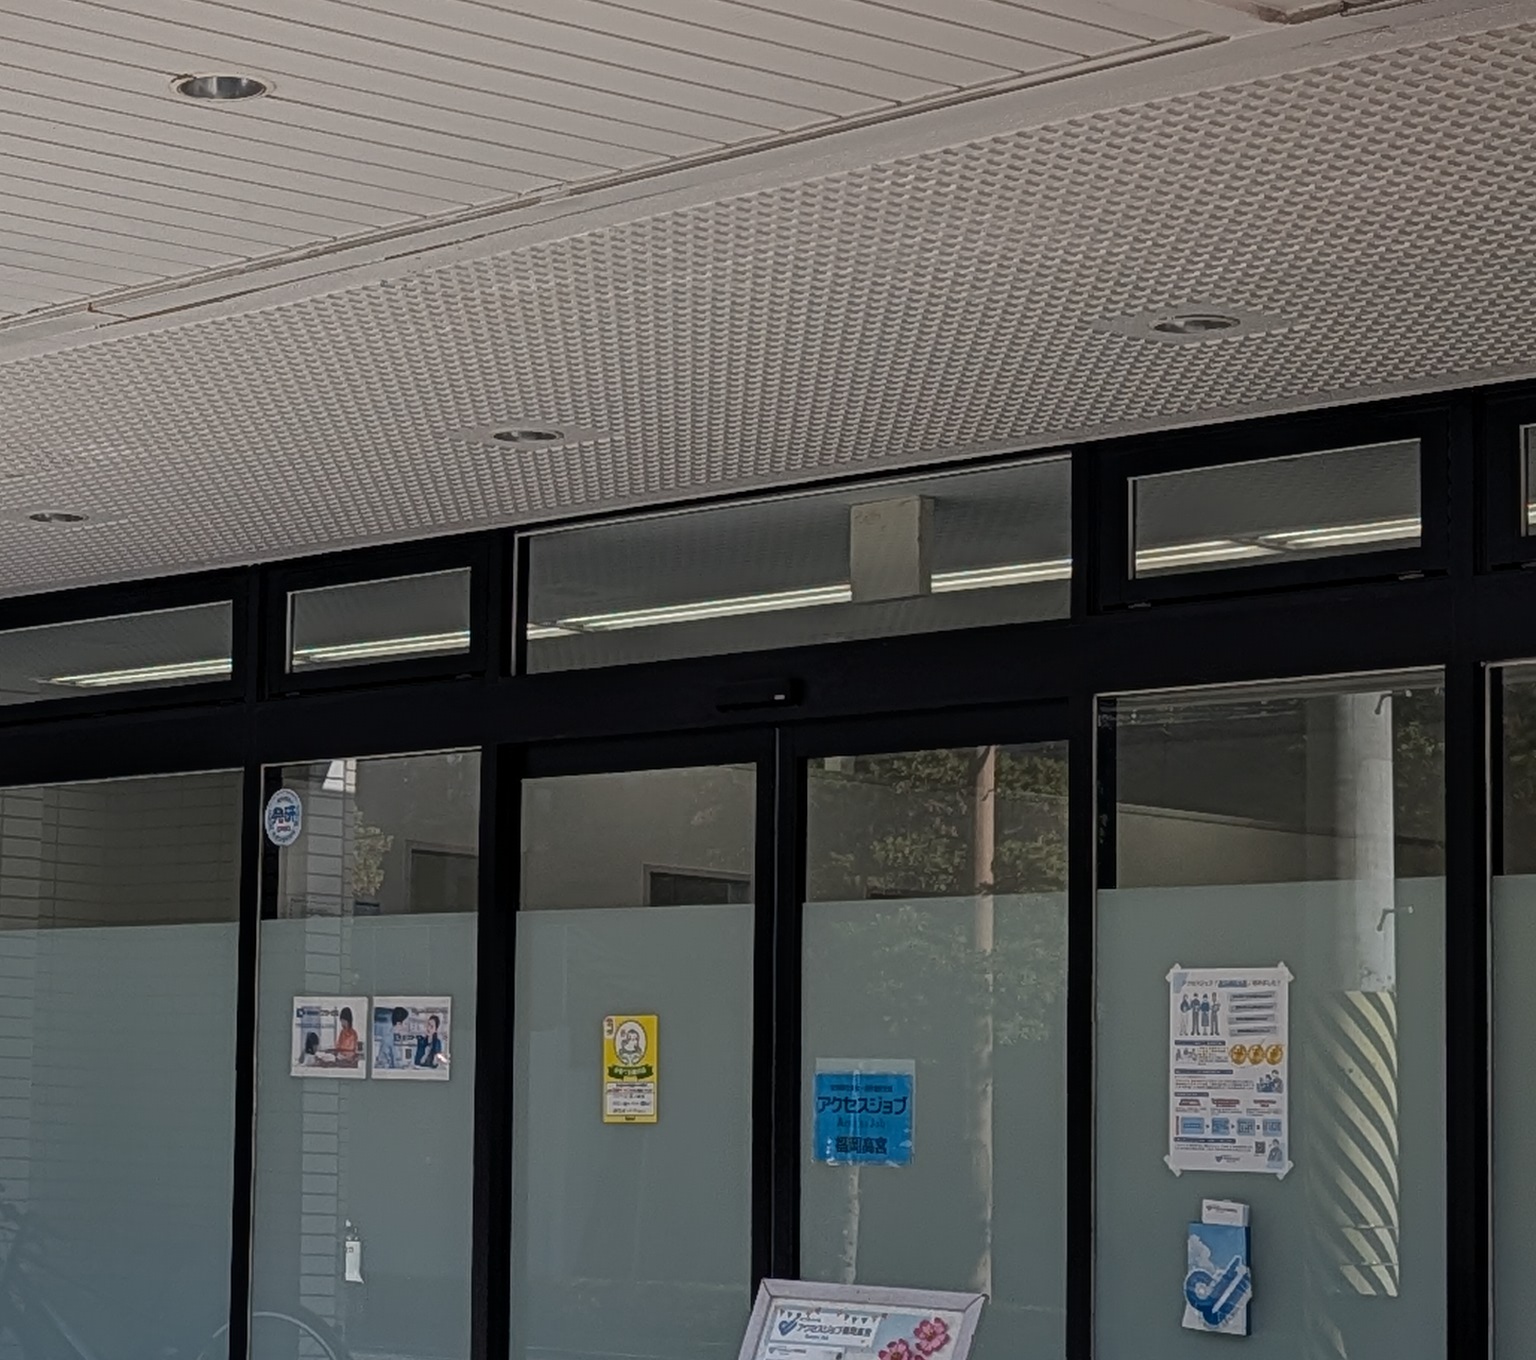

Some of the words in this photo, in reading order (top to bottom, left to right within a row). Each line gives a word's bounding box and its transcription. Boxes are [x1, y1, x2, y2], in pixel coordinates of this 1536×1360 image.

[816, 1096, 909, 1116] アクセスジョブ
